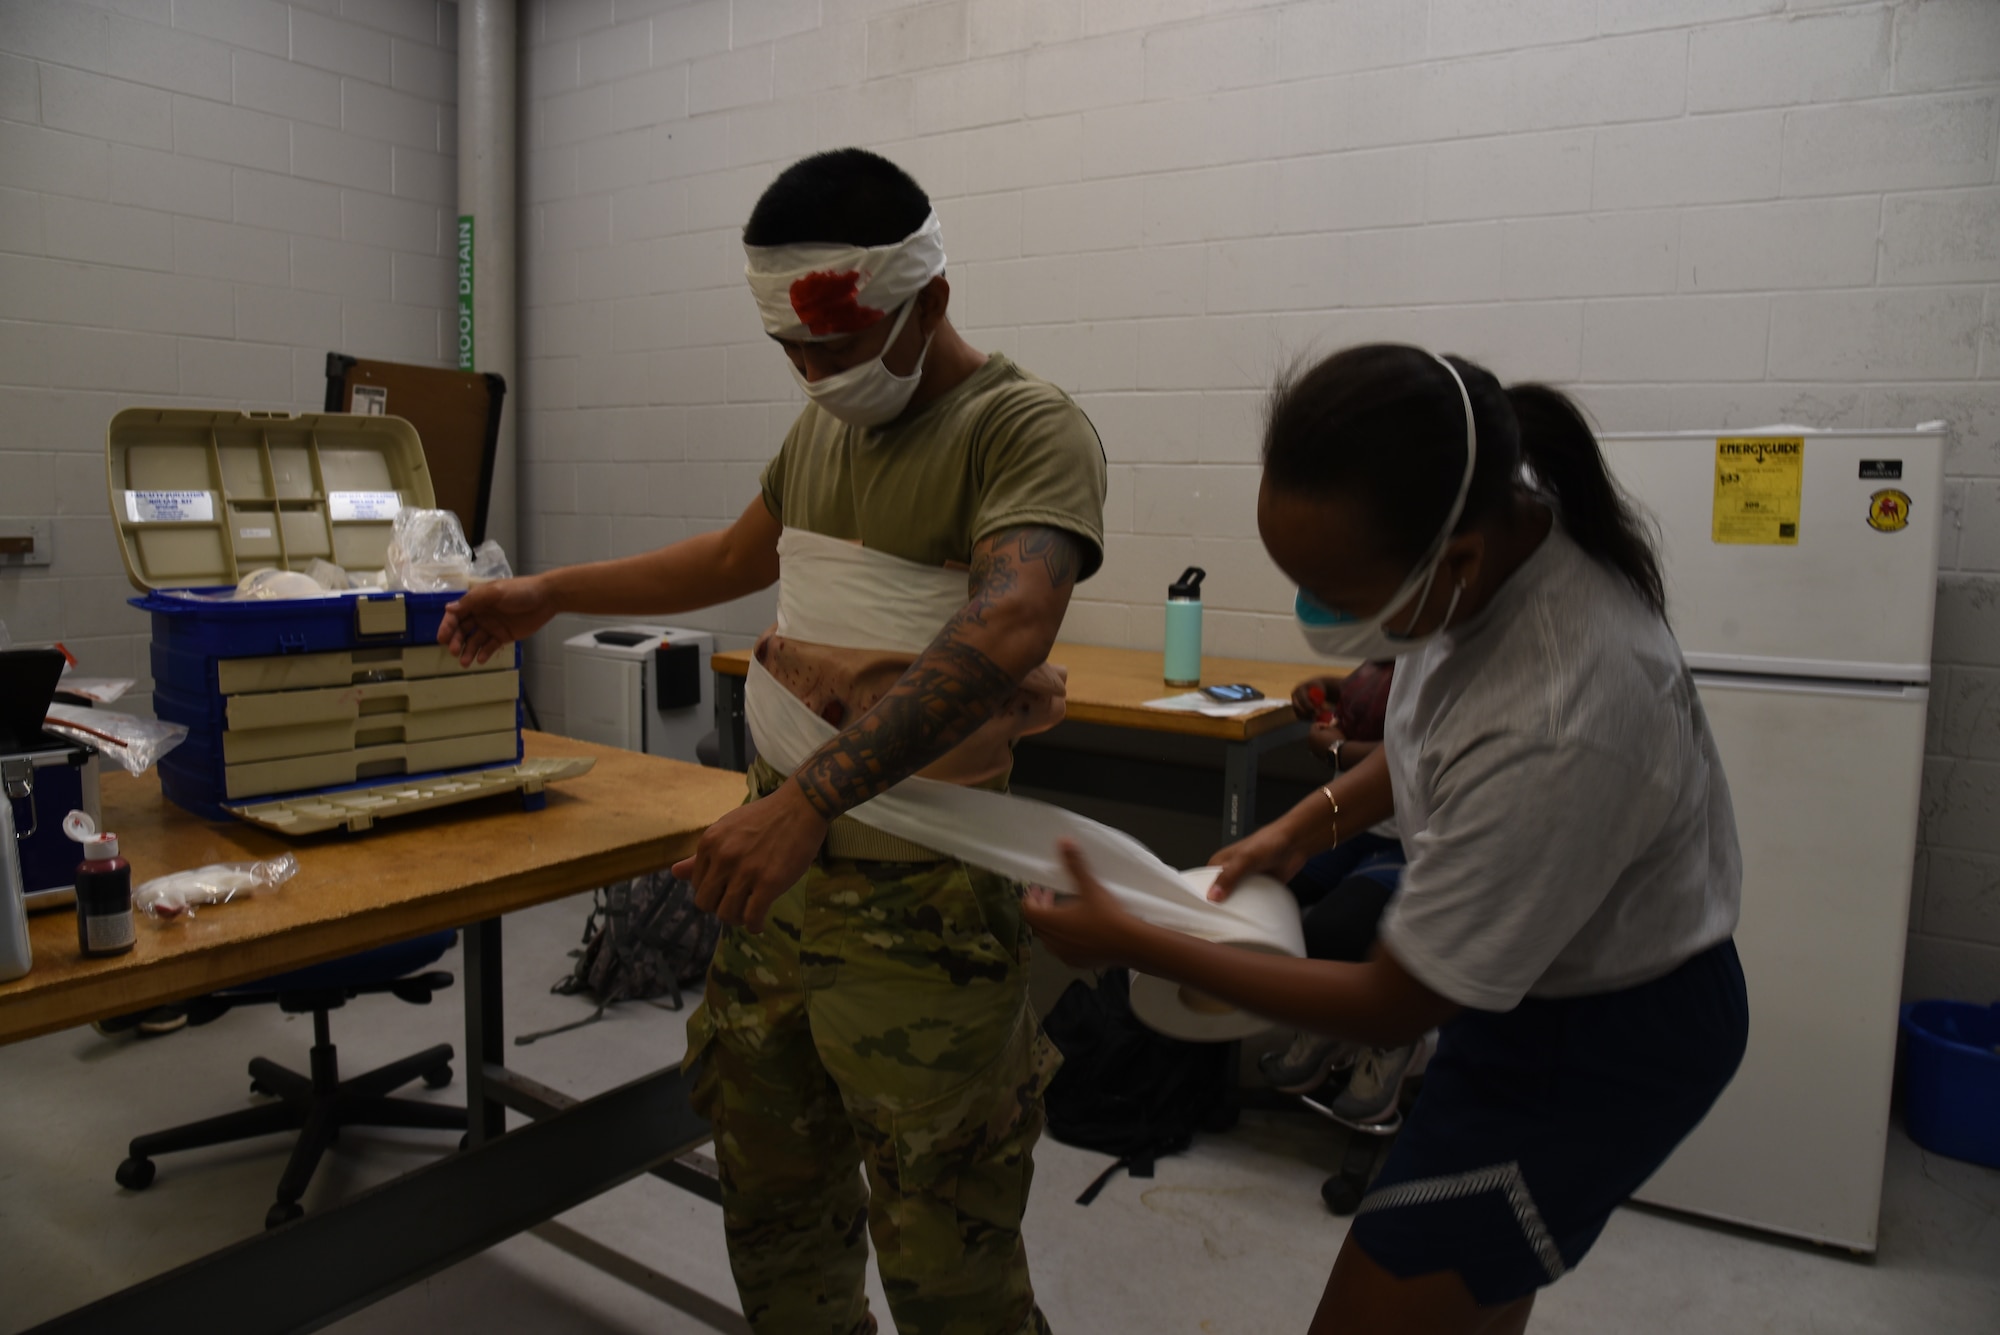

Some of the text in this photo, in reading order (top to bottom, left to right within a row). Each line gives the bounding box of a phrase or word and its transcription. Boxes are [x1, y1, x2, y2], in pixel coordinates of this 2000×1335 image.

[459, 222, 471, 368] ROOF DRAIN
[1720, 443, 1800, 457] ENERGYGUIDE
